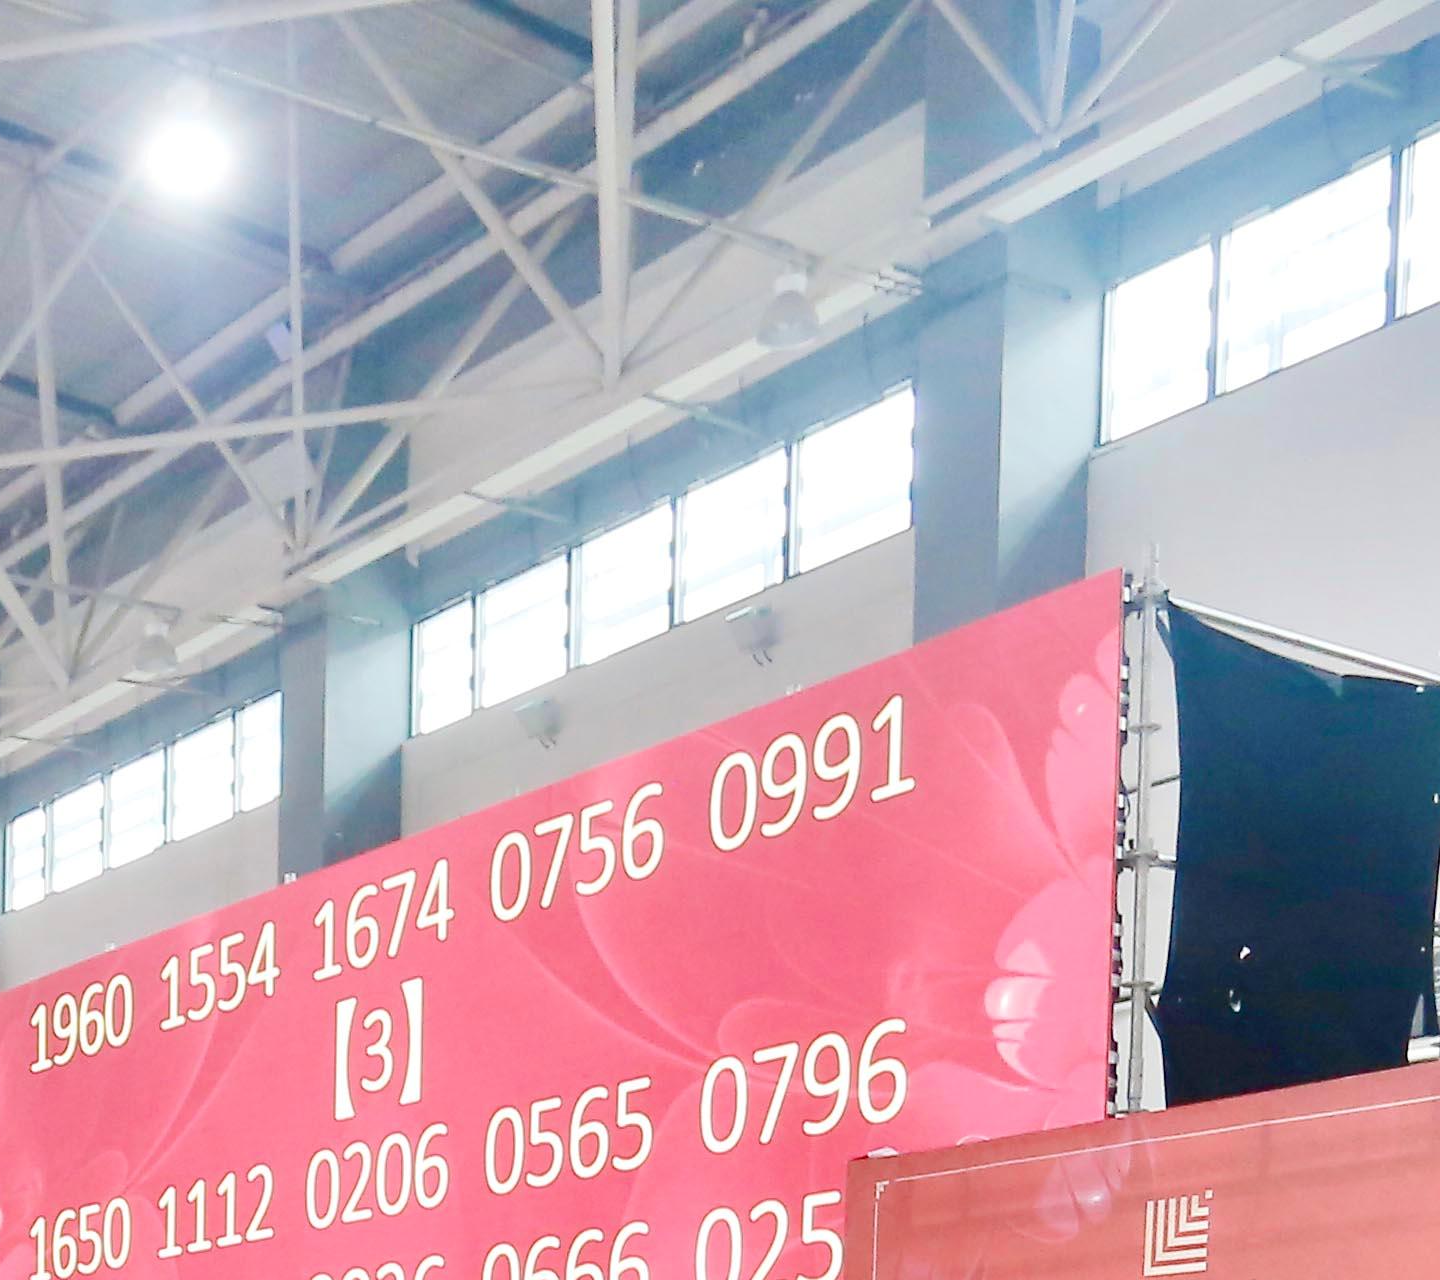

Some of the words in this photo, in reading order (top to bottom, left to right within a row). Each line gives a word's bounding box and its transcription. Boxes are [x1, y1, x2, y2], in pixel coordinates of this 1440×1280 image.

[29, 972, 133, 1073] 1960
[158, 919, 281, 1031] 1554
[312, 857, 455, 982] 1674
[487, 780, 666, 922] 0756
[707, 693, 916, 851] 0991
[157, 1164, 274, 1259] 1112
[306, 1123, 449, 1230] 0206
[485, 1076, 653, 1195] 0565
[700, 1018, 908, 1157] 0796
